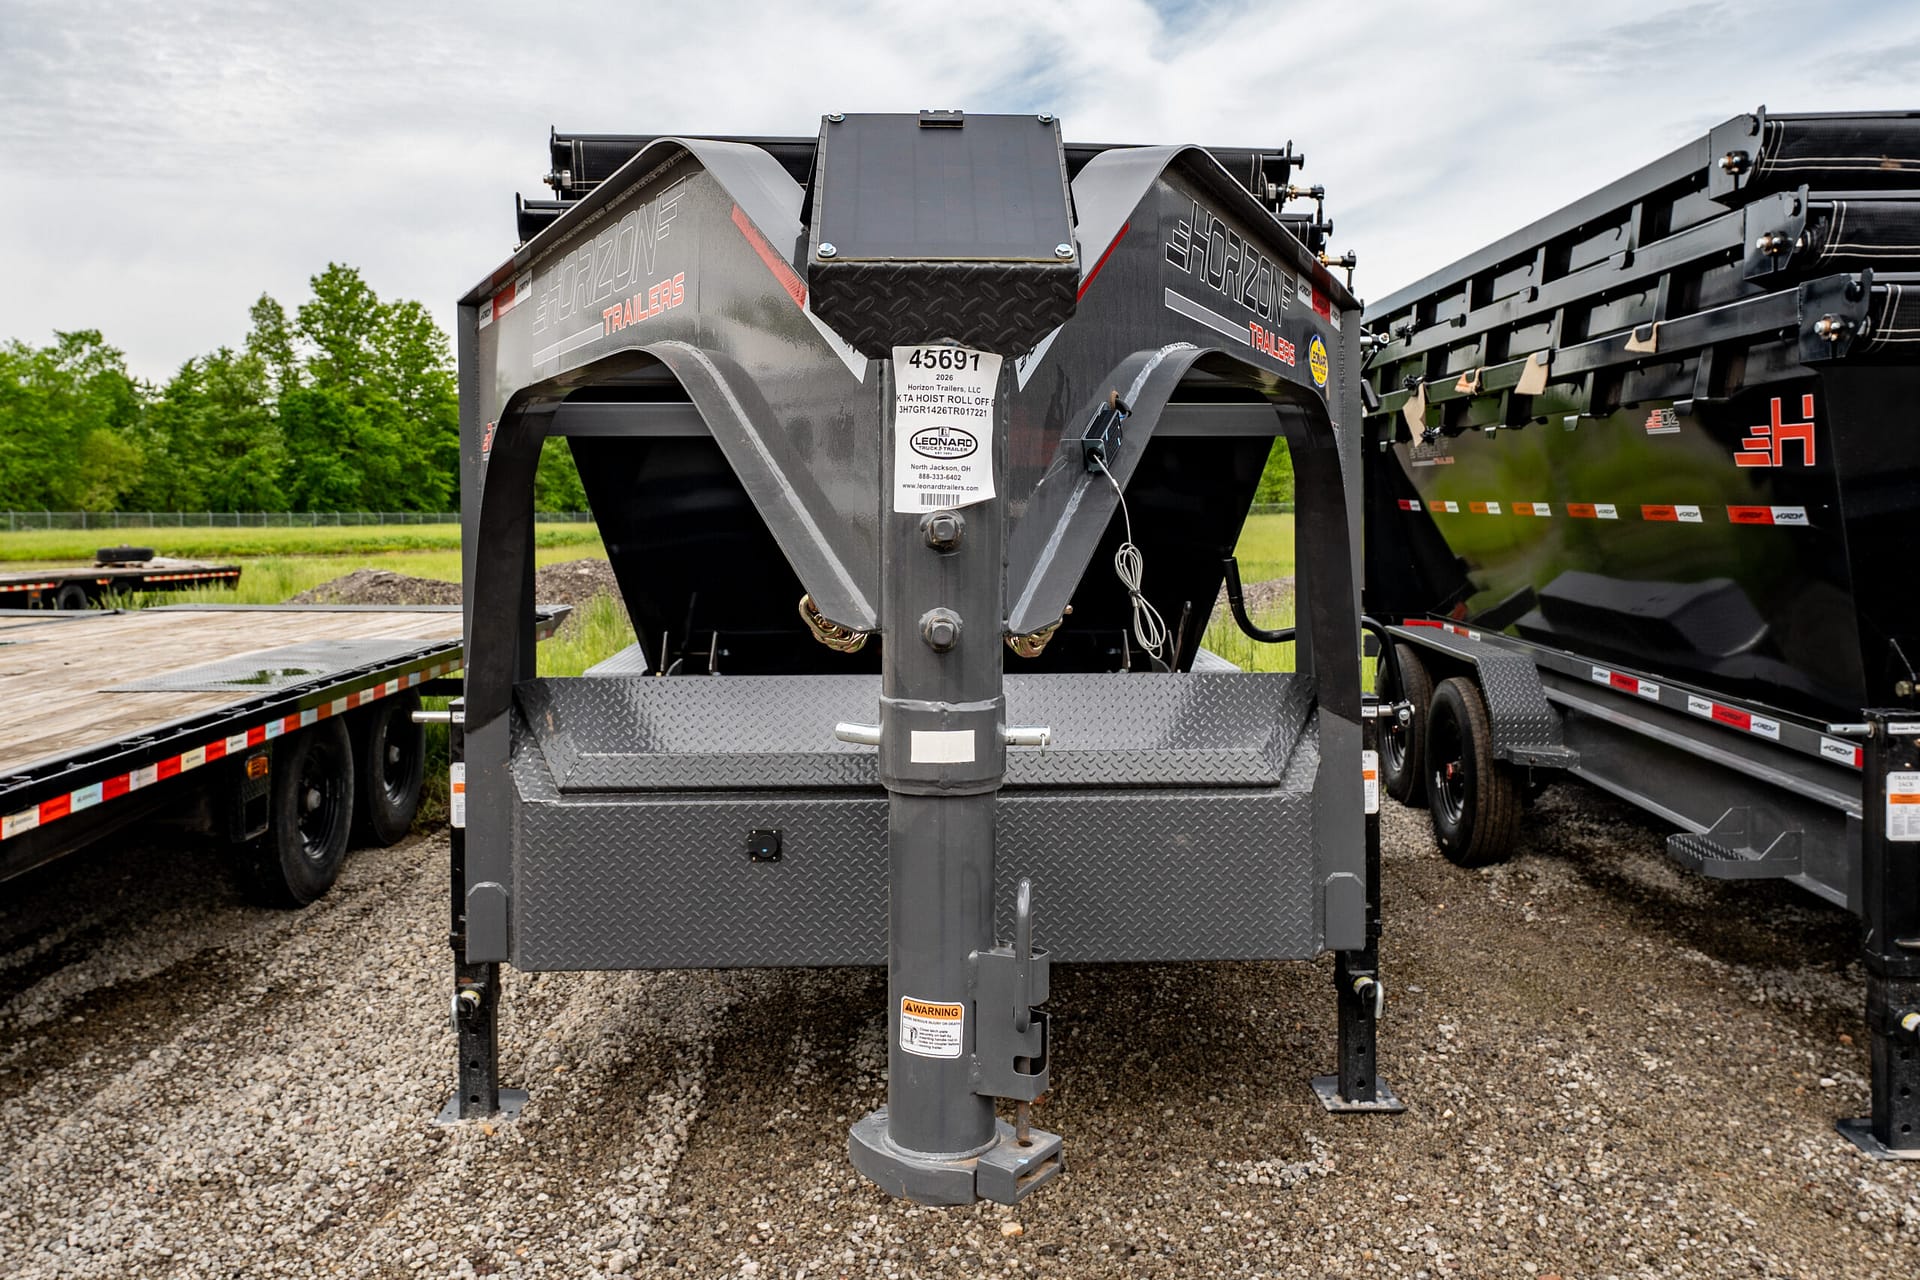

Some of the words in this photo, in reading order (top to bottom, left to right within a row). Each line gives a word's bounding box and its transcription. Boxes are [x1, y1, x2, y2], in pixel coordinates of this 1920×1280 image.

[533, 177, 686, 335] HORIZON
[1166, 201, 1294, 327] HORIZON
[602, 272, 685, 336] TRAILERS
[1249, 321, 1296, 367] TRAILERS
[909, 349, 980, 371] 45691
[907, 383, 935, 391] Horizon
[936, 384, 967, 393] Trailers,
[968, 386, 982, 394] LLC
[903, 394, 914, 403] TA
[916, 394, 945, 403] HOIST
[947, 395, 973, 405] ROLL
[974, 397, 990, 406] OFF
[915, 437, 973, 447] LEONARD
[930, 464, 959, 472] Jackson,
[918, 473, 962, 481] 888-333-6402
[902, 483, 979, 491] www.leonardtrailers.com
[913, 1003, 958, 1017] WARNING
